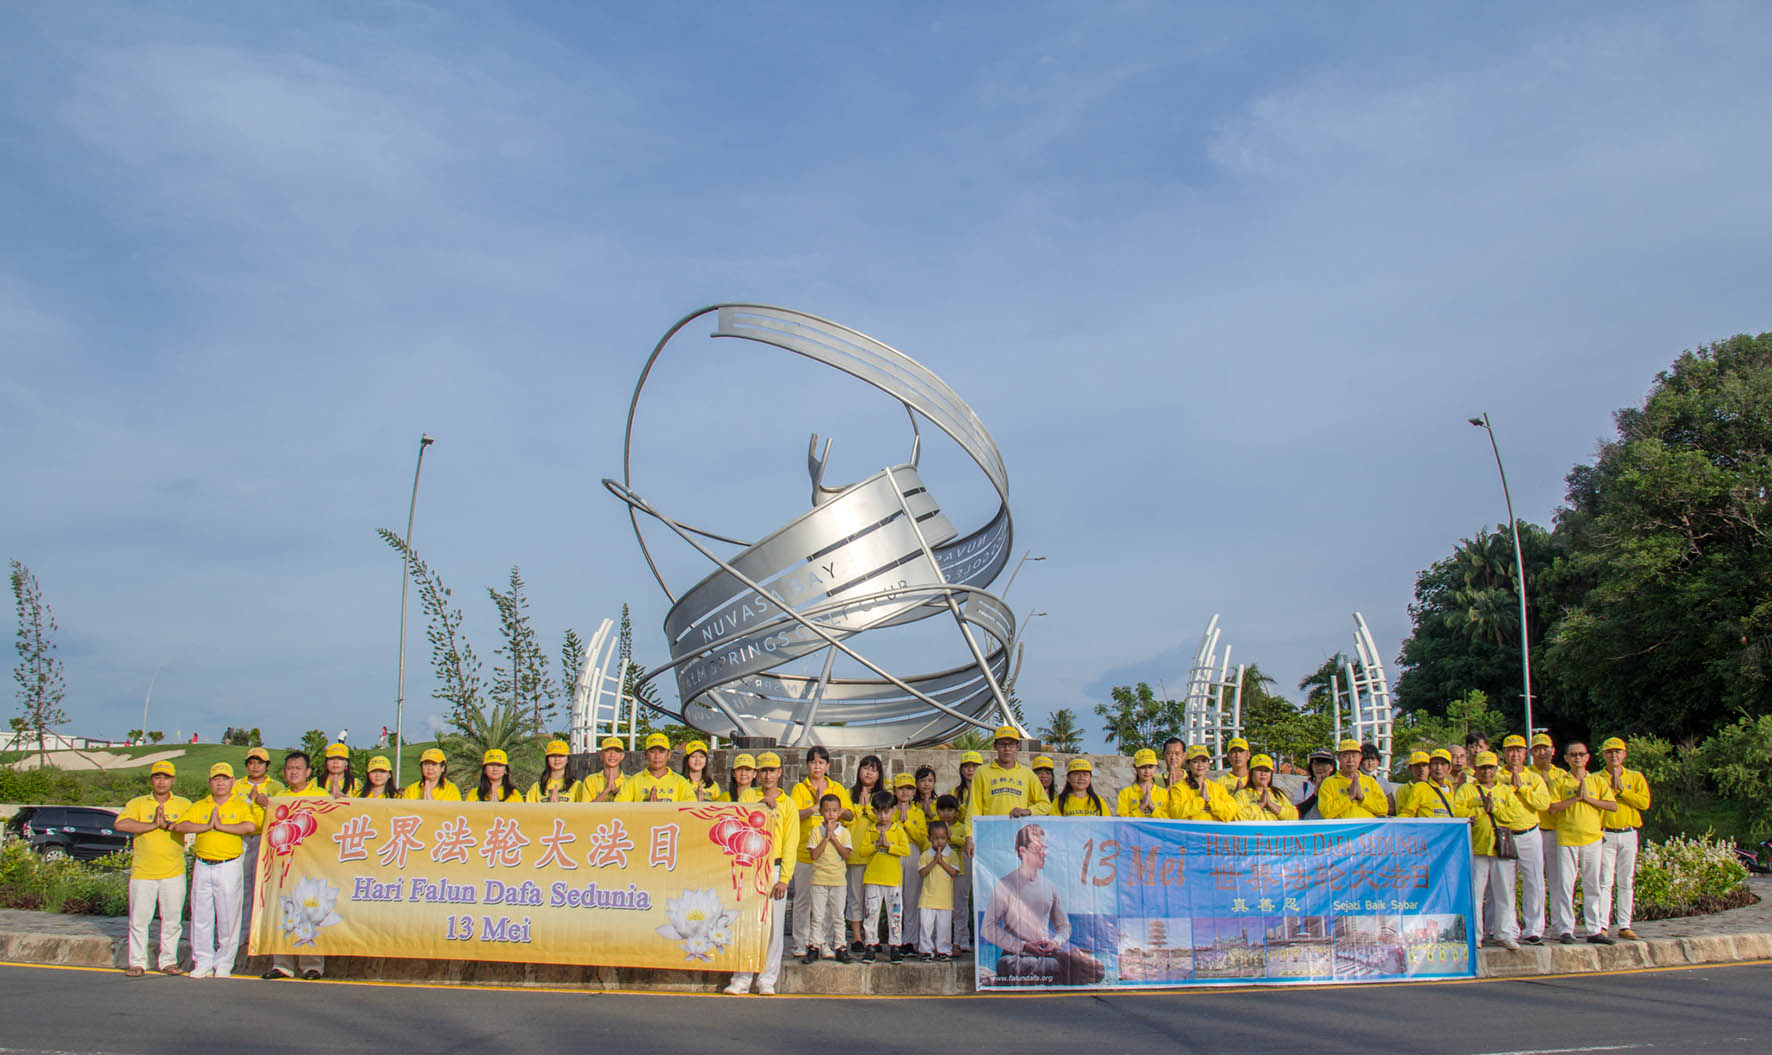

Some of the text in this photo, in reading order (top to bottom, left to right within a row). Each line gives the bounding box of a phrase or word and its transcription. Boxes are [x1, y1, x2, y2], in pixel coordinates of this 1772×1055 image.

[702, 562, 835, 644] NUVASA BAY
[332, 814, 680, 872] 世界法轮大法日
[1206, 832, 1430, 856] HARI FALUN DAFA SEDUNIA
[1080, 838, 1187, 887] 13 Mei
[1209, 863, 1430, 892] 世界法轮大法日
[351, 876, 651, 910] Hari Falun Dafa Sedunia
[1333, 899, 1420, 913] Sejati Baik Sabar
[446, 915, 532, 943] 13 Mei
[991, 974, 1054, 983] www.falundafa.org
